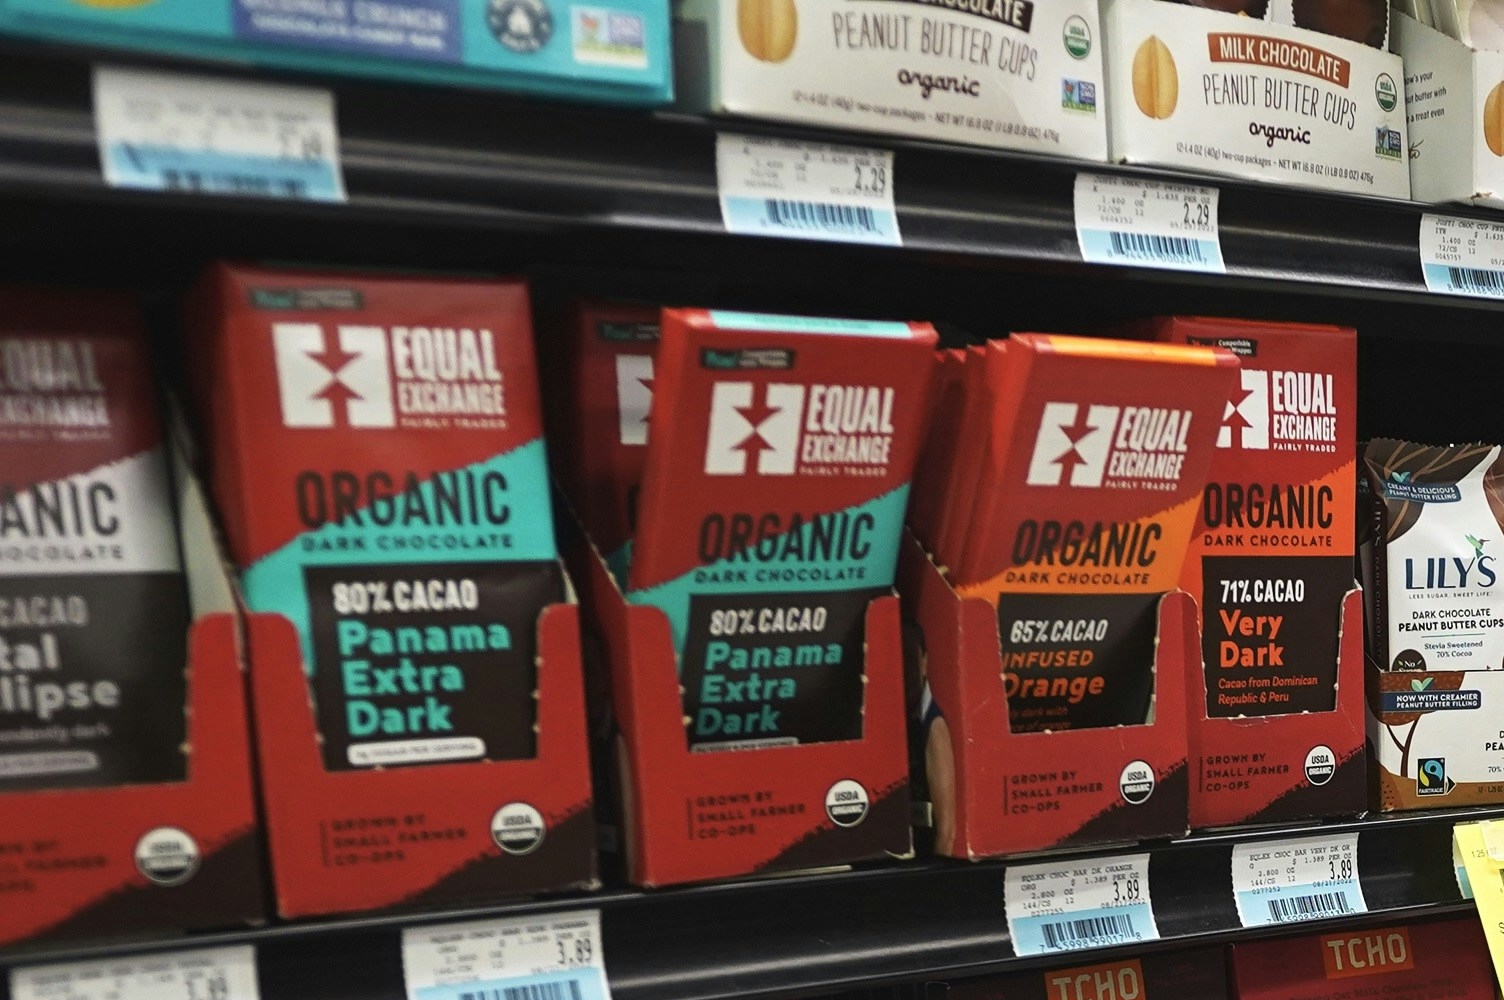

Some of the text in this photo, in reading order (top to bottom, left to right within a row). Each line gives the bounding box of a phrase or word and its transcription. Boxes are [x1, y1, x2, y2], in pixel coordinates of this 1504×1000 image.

[832, 12, 1039, 81] PEANUT BUTTER CUPS
[1219, 36, 1341, 82] MILK CHOCOLATE
[898, 68, 981, 100] organic
[1203, 73, 1357, 131] PEANUT BUTTER CUPS
[1249, 121, 1311, 147] organic
[854, 168, 886, 193] 2.29
[391, 326, 501, 381] EQUAL
[397, 382, 506, 416] EXCHANGE
[806, 383, 894, 434] EQUAL
[802, 434, 893, 465] EXCHANGE
[296, 468, 512, 531] ORGANIC
[301, 532, 516, 554] DARK CHOCOLATE
[698, 511, 875, 564] ORGANIC
[1204, 533, 1333, 547] DARK CHOCOLATE
[694, 567, 866, 584] DARK CHOCOLATE
[1005, 571, 1150, 586] DARK CHOCOLATE
[1220, 579, 1305, 603] 71% CACAO
[337, 620, 511, 656] Panama
[705, 640, 843, 671] Panama
[342, 660, 465, 697] Extra
[701, 673, 797, 703] Extra
[1218, 674, 1319, 690] Cacao from Dominican
[346, 700, 453, 737] Dark
[696, 704, 781, 736] Dark
[1329, 859, 1353, 882] 3.89
[1113, 879, 1140, 902] 3.89
